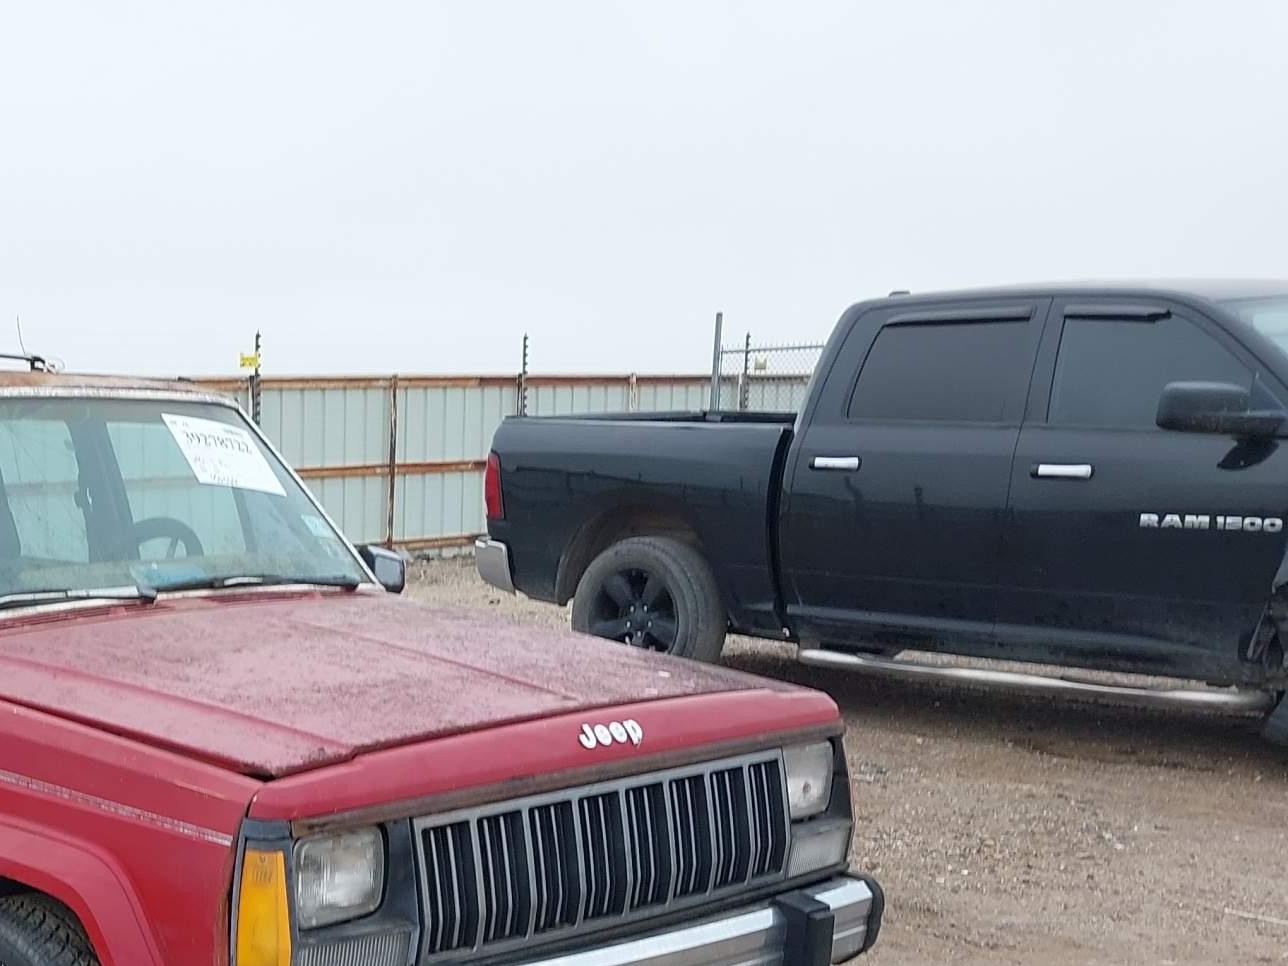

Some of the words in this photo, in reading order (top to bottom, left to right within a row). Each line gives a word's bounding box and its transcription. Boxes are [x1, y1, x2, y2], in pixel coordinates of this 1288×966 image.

[1139, 513, 1210, 530] RAM
[1215, 515, 1283, 533] 1500
[579, 719, 643, 749] Jeep
